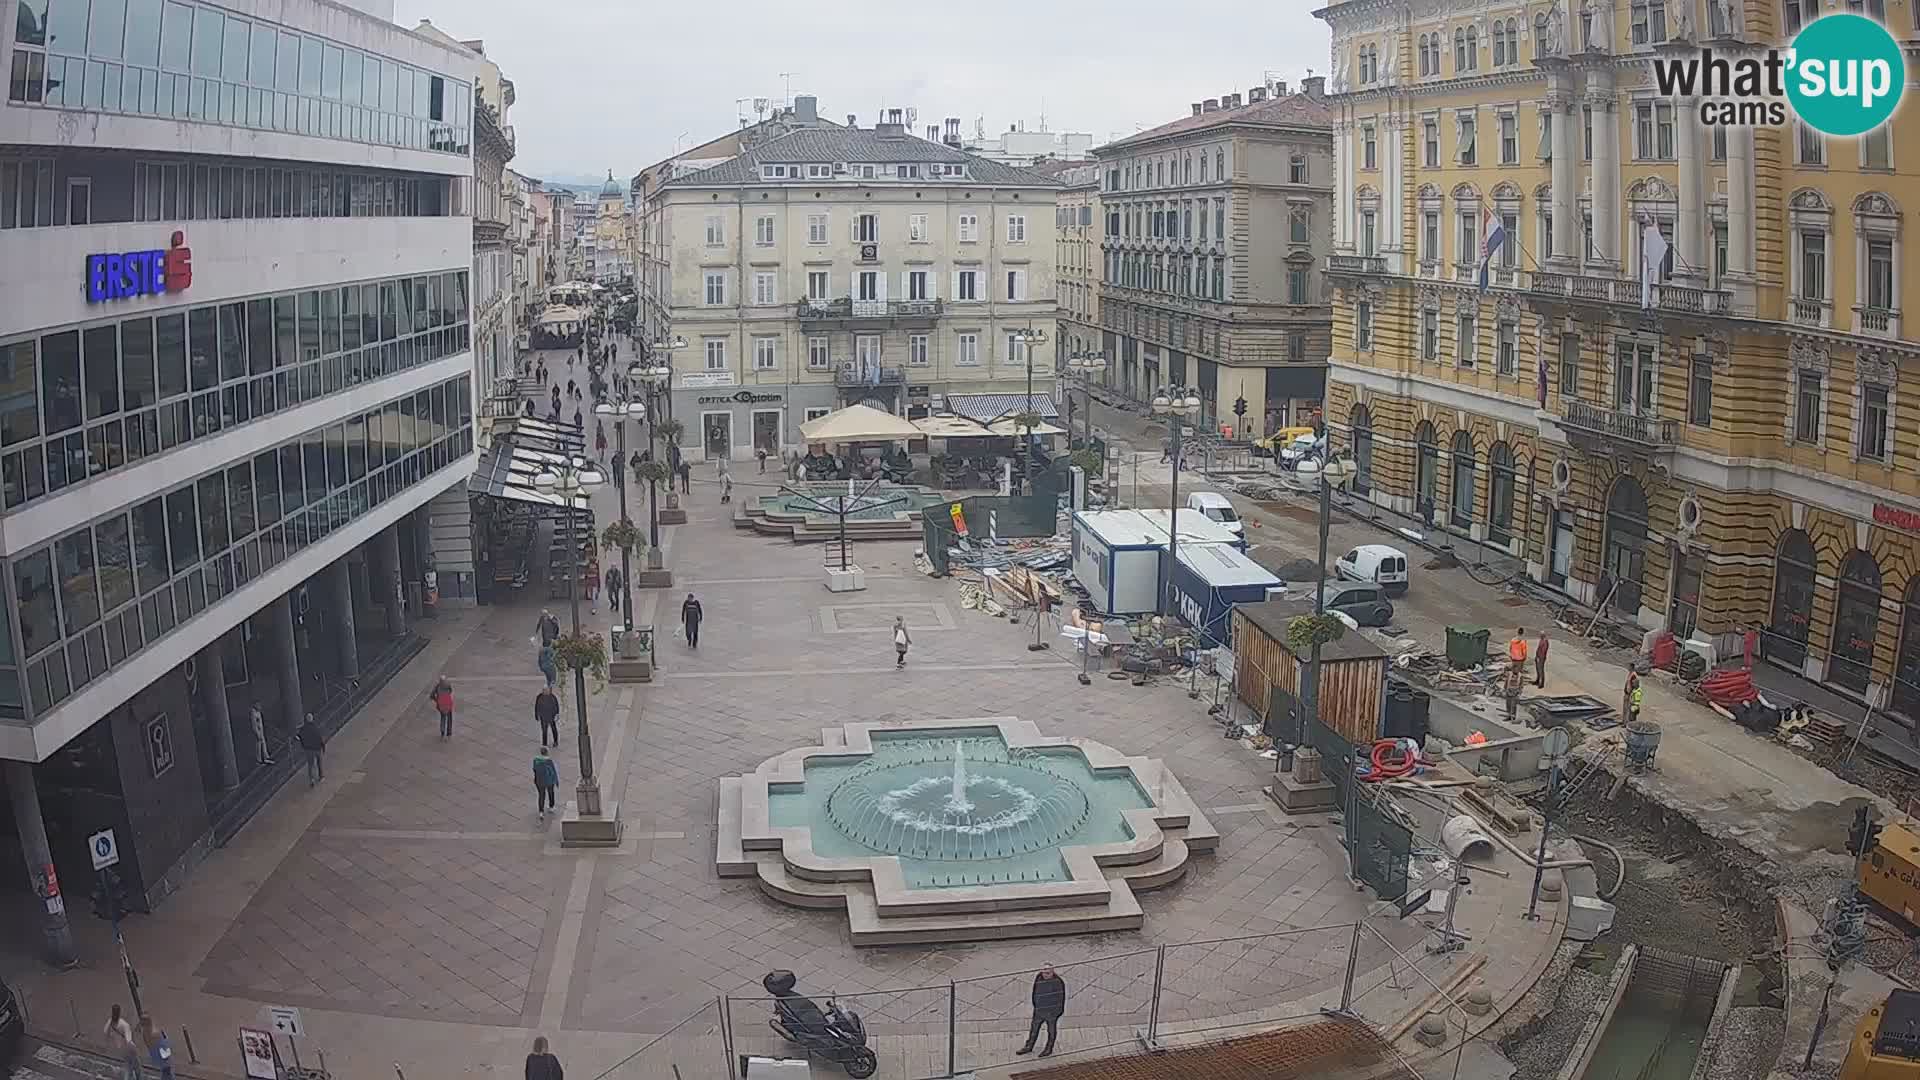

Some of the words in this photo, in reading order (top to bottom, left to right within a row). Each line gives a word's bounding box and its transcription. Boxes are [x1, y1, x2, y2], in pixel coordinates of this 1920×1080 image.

[86, 249, 165, 303] ERSTE
[698, 396, 732, 404] OPTIKA
[1181, 591, 1203, 630] KRK
